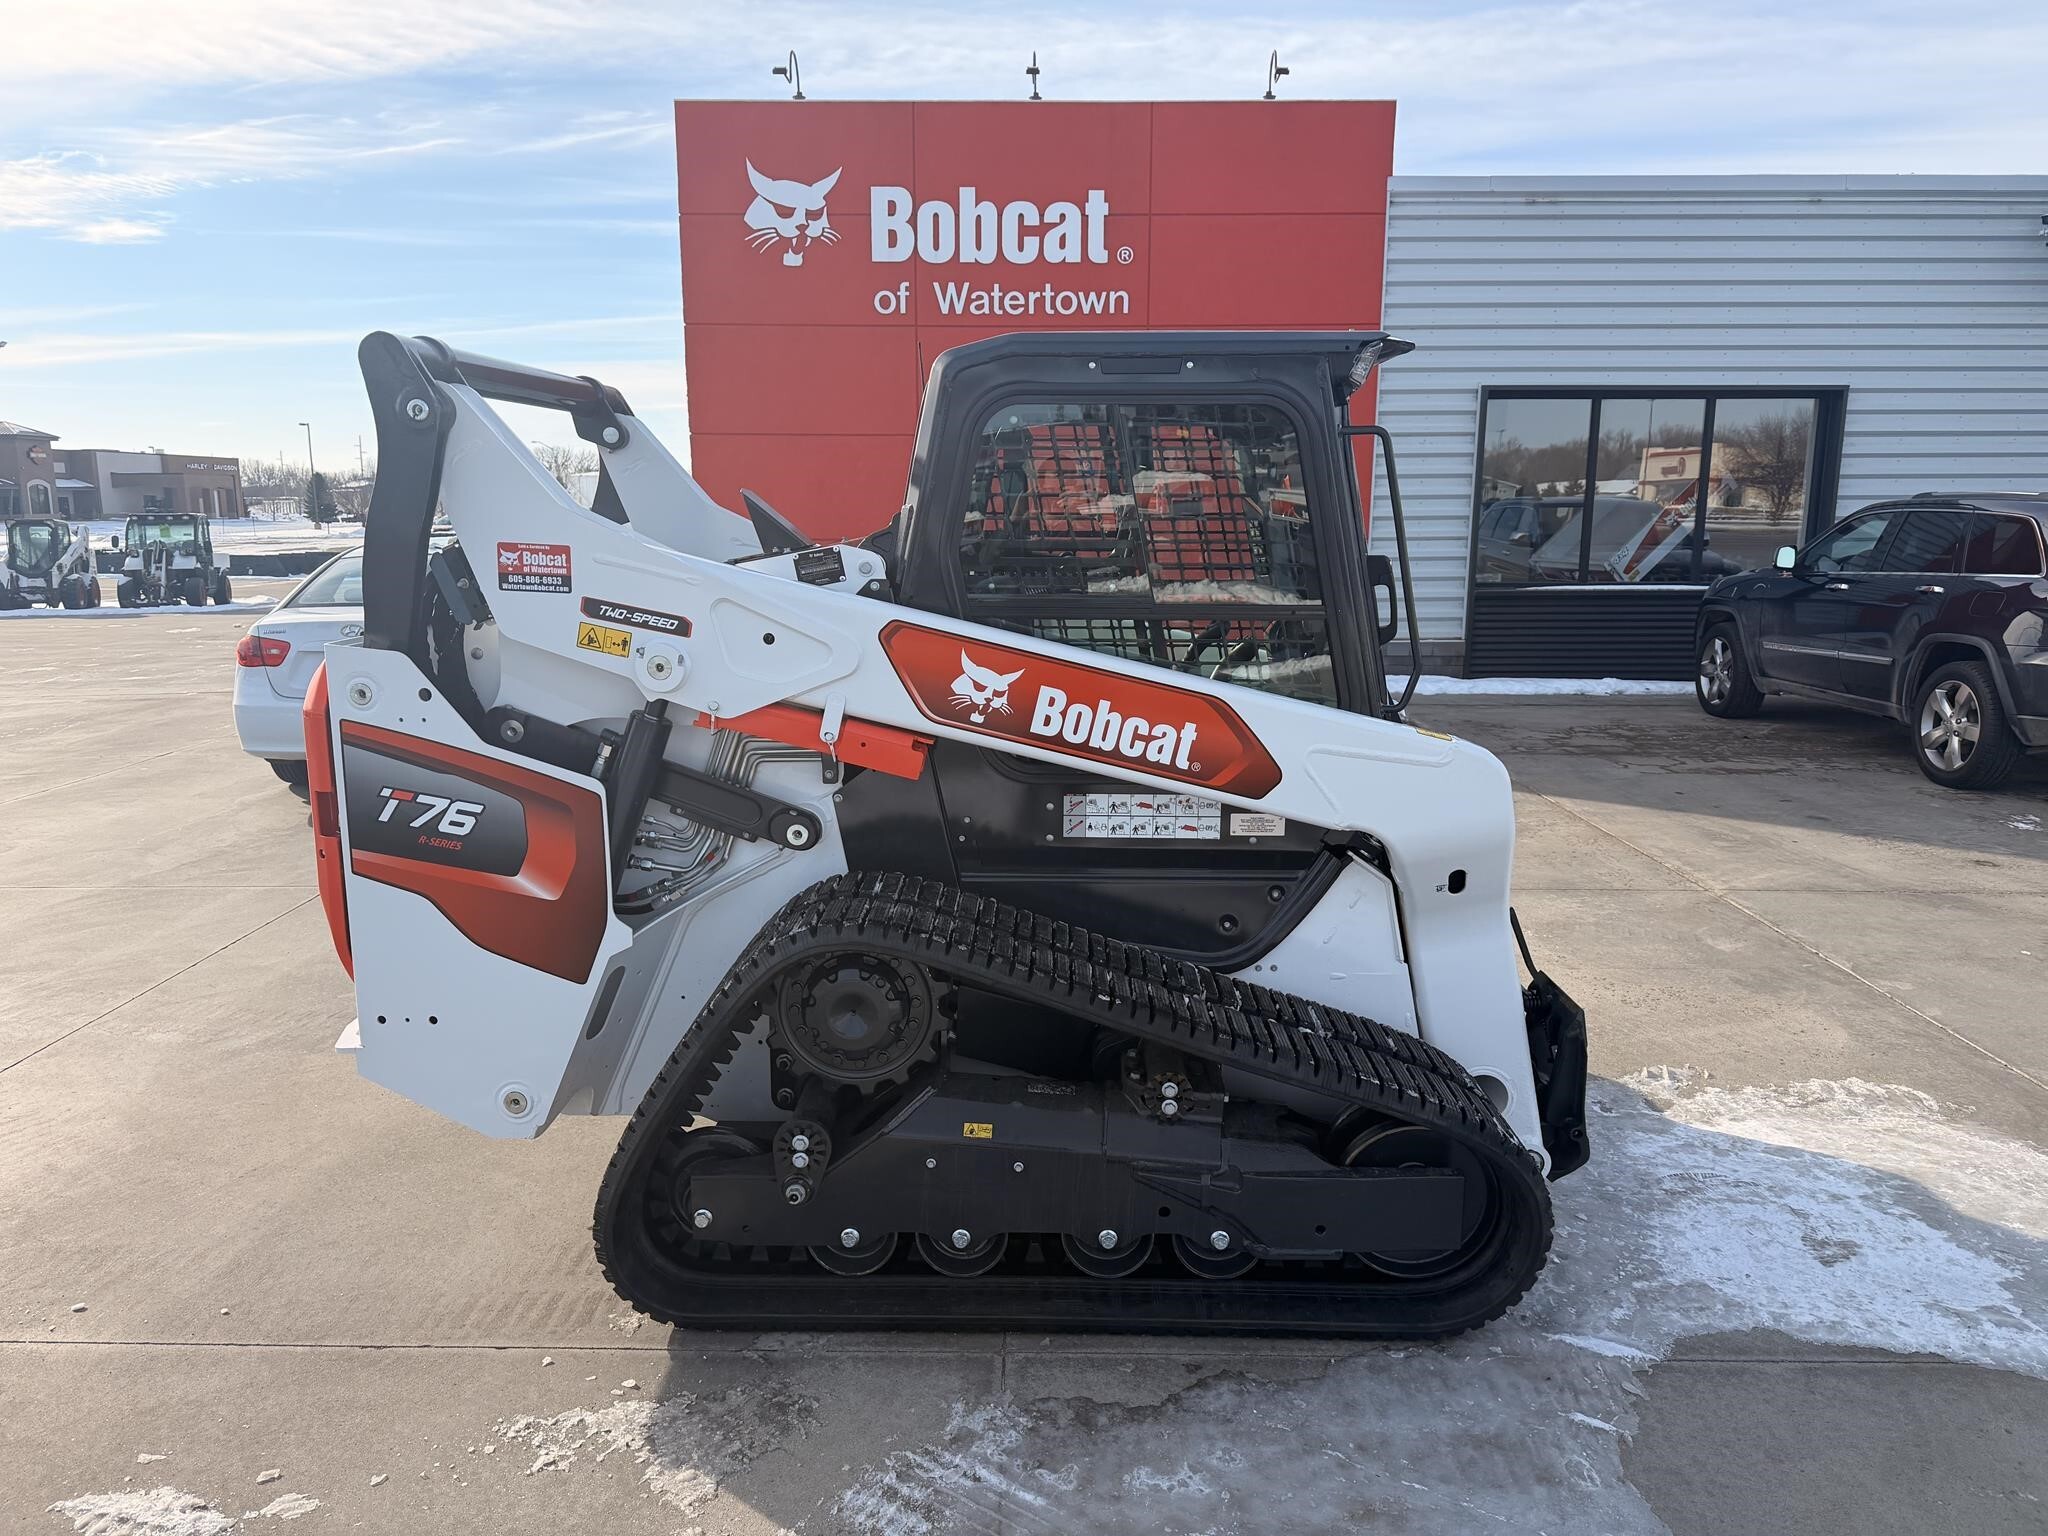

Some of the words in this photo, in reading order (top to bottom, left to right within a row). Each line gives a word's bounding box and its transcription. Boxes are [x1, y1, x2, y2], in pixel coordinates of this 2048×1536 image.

[870, 186, 1109, 264] Bobcat
[874, 282, 909, 315] of
[933, 282, 1129, 314] Watertown
[522, 551, 567, 567] Bobcat
[531, 566, 567, 575] Watertown
[508, 574, 562, 585] 605-886-6933
[600, 605, 679, 629] TWO-SPEED
[1030, 685, 1198, 769] Bobcat
[378, 787, 484, 835] T76
[418, 835, 463, 849] R-SERIES
